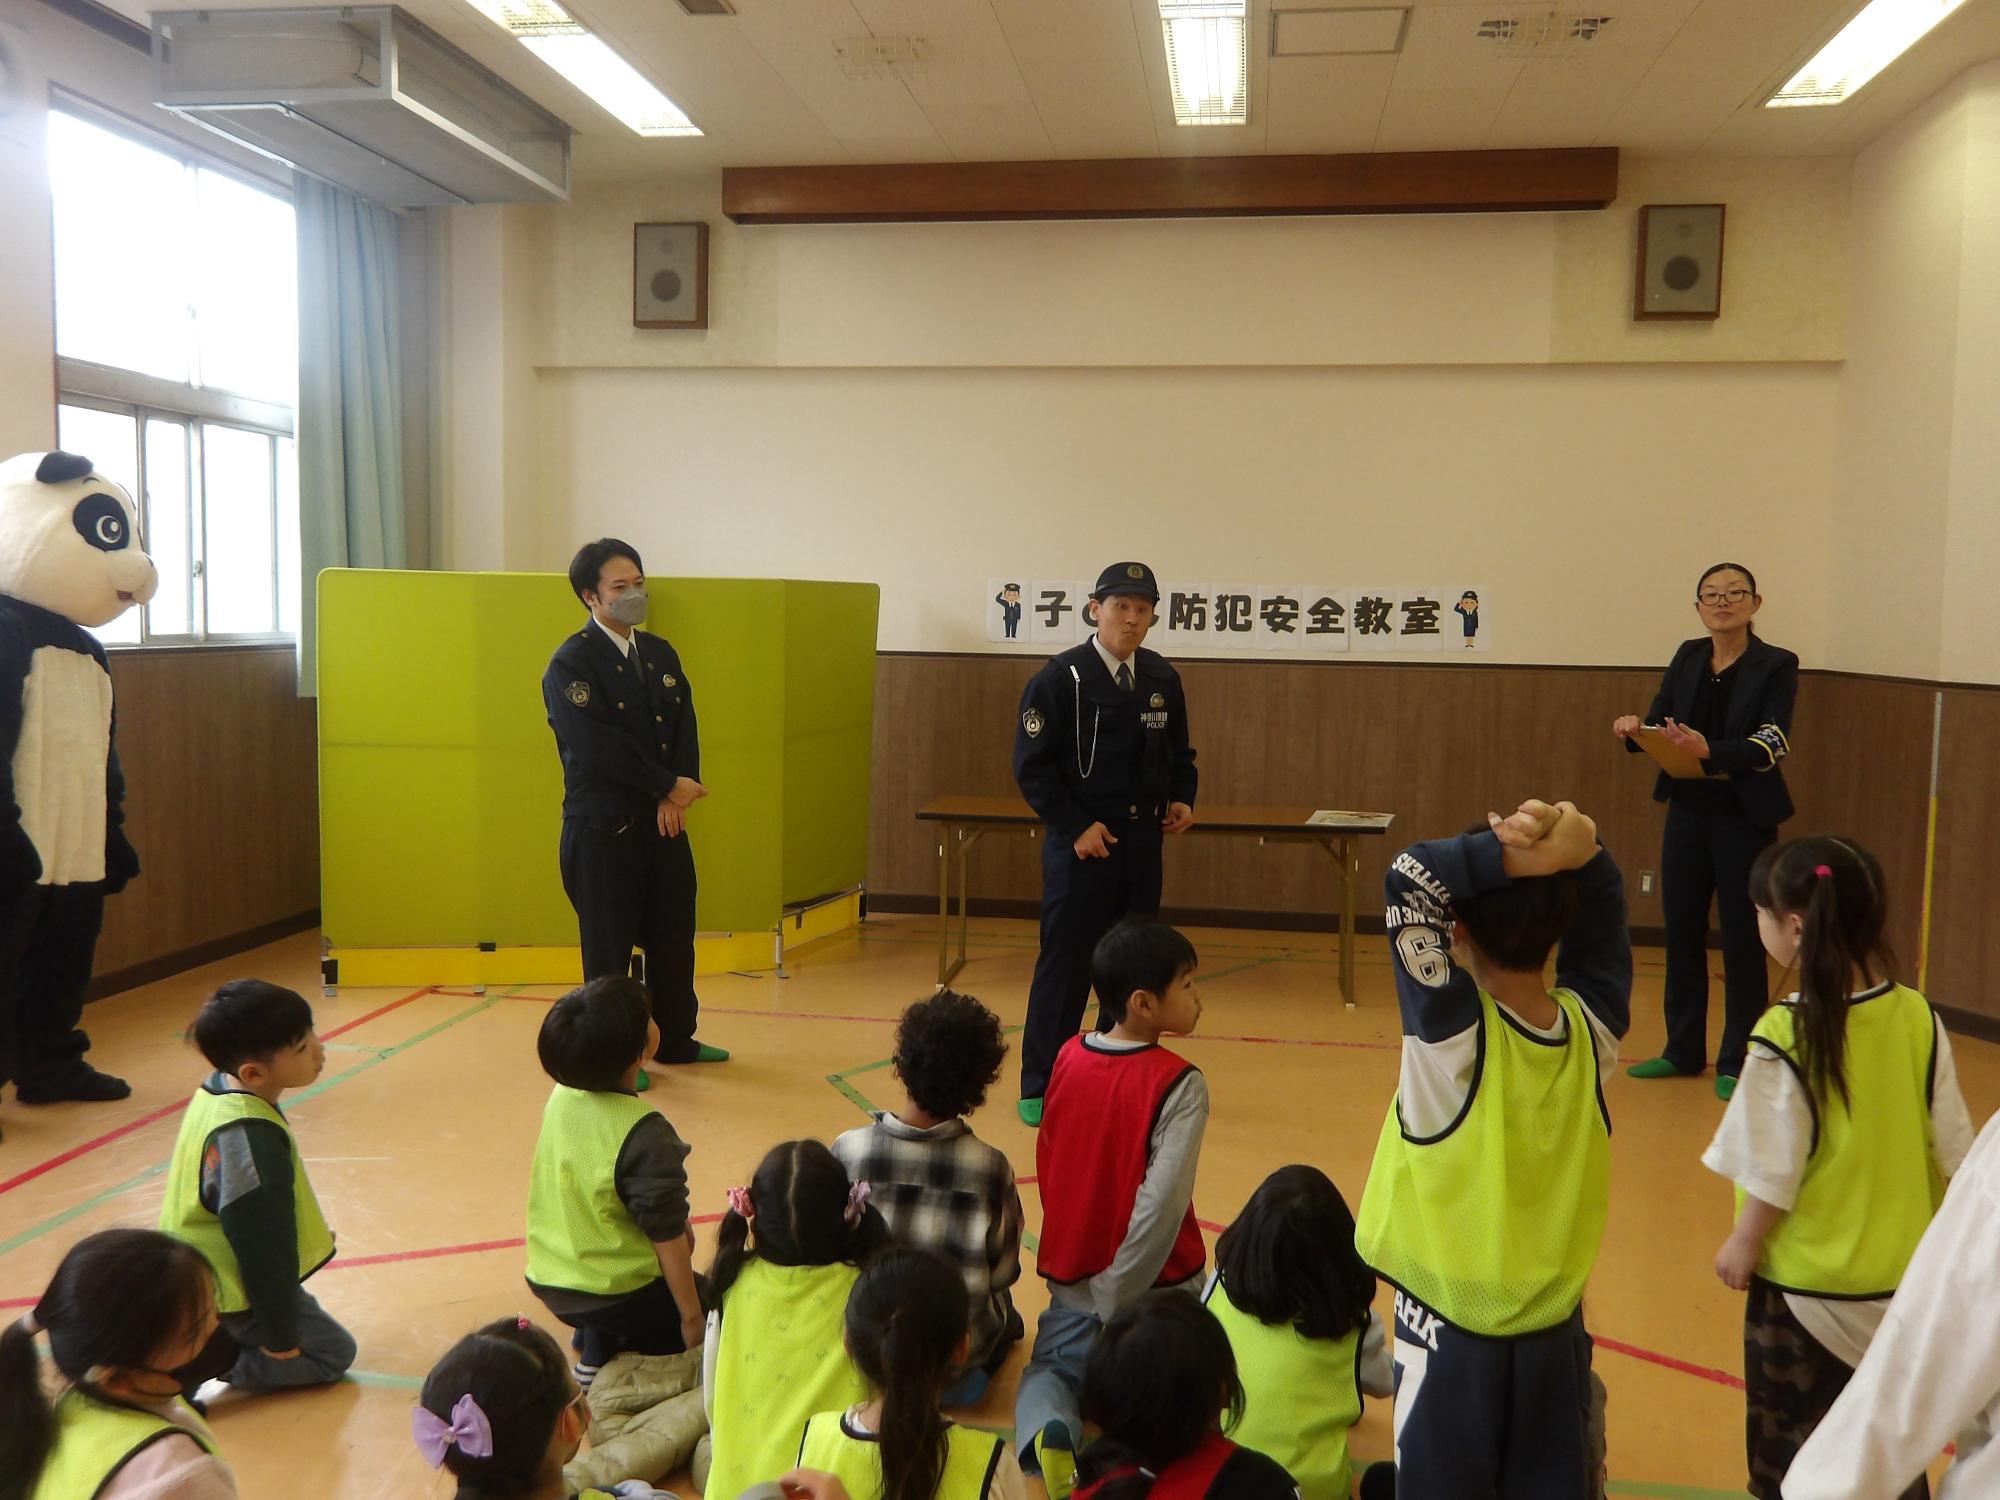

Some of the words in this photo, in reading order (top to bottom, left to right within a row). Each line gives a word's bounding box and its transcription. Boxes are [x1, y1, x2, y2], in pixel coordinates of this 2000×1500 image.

[1035, 590, 1441, 636] 子防犯安全教室
